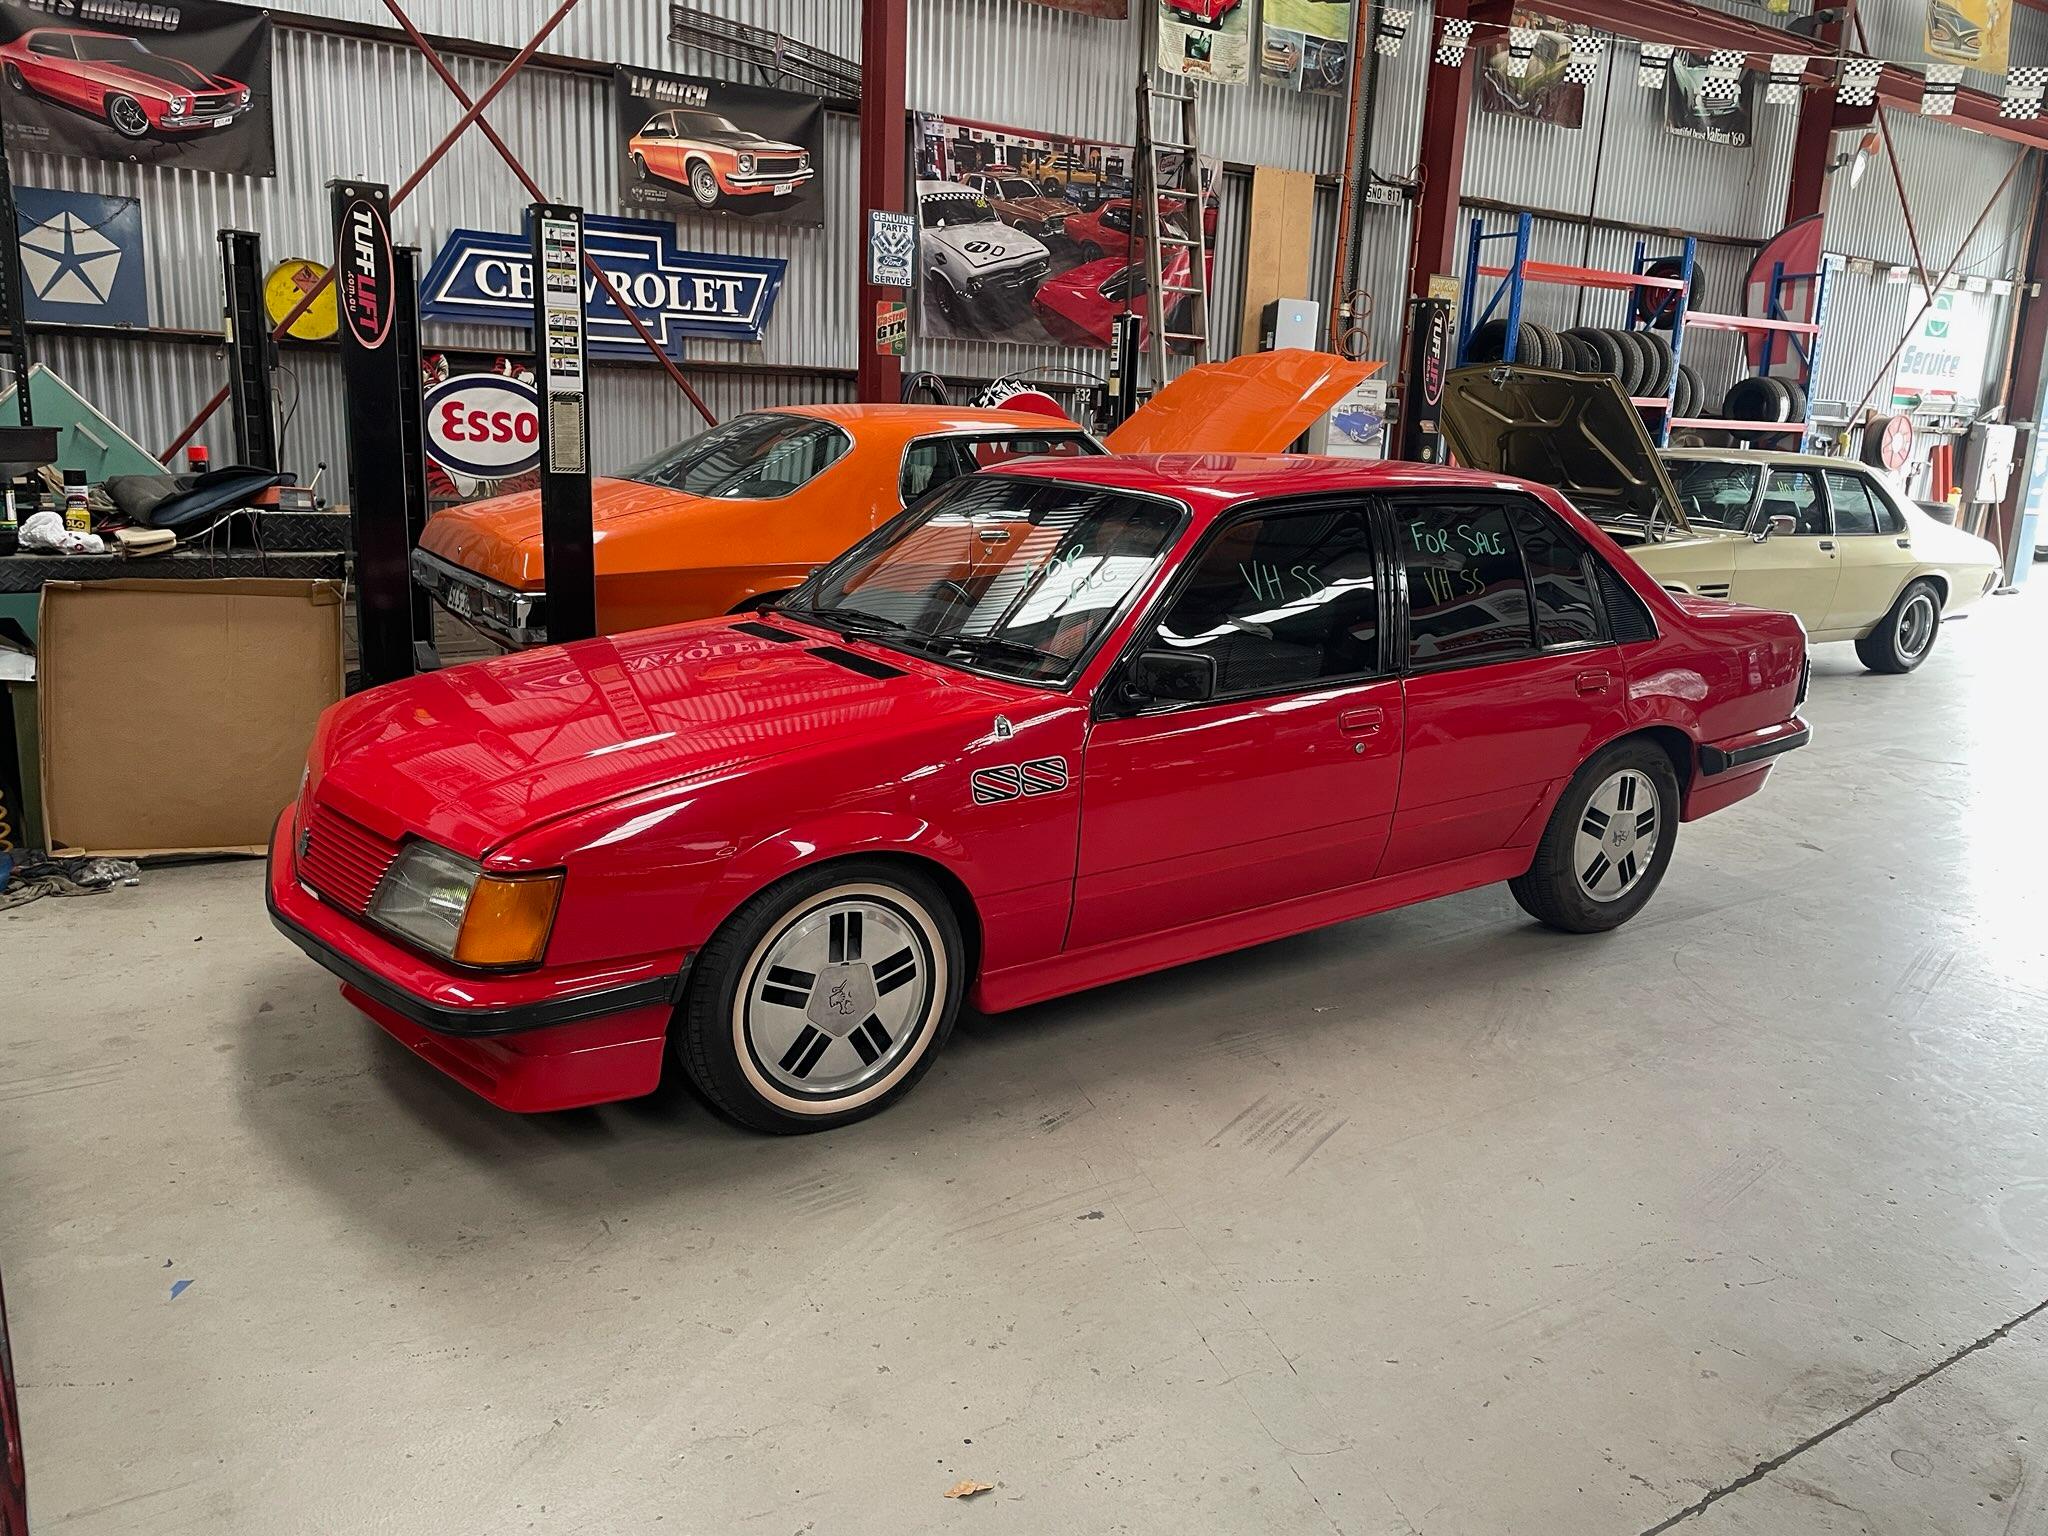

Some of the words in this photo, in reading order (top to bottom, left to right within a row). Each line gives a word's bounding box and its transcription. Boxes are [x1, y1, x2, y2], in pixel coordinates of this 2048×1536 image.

[630, 75, 653, 98] LX
[655, 79, 709, 107] HATCH
[1706, 126, 1730, 144] Valiant
[1732, 132, 1745, 146] '69
[1387, 189, 1401, 203] 817
[872, 211, 915, 225] GENUINE
[881, 223, 909, 233] PARTS
[882, 255, 904, 266] Ford
[474, 260, 743, 315] CHVROLET
[874, 275, 911, 286] SERVICE
[877, 310, 907, 327] Castrol
[877, 319, 906, 340] GTX
[1901, 345, 1960, 376] Service
[441, 401, 539, 443] Esso
[1411, 521, 1455, 553] FOR
[1457, 524, 1506, 556] SALE
[1239, 560, 1285, 601] VH
[1290, 564, 1328, 601] SS
[1423, 567, 1455, 607] VH
[1460, 567, 1487, 596] SS
[971, 756, 1068, 805] SS
